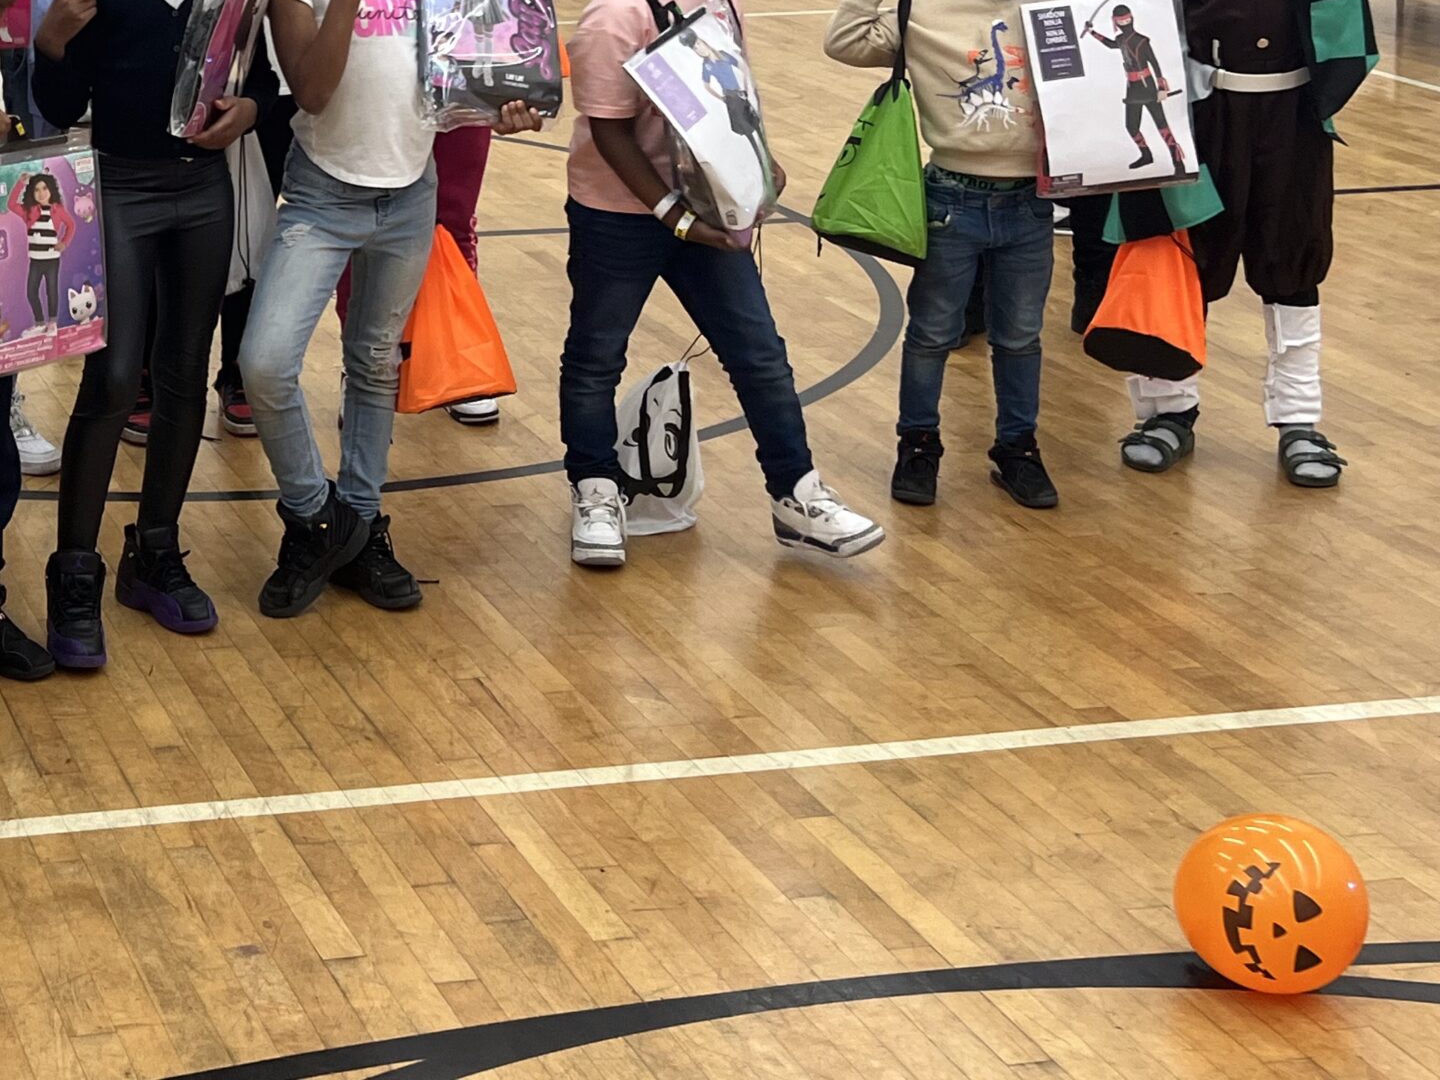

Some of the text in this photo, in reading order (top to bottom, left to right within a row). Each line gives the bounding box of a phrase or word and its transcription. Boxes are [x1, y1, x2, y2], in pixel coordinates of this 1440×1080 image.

[1037, 10, 1066, 21] SHADOW
[1043, 18, 1063, 27] NINJA
[1045, 29, 1065, 38] NINJA
